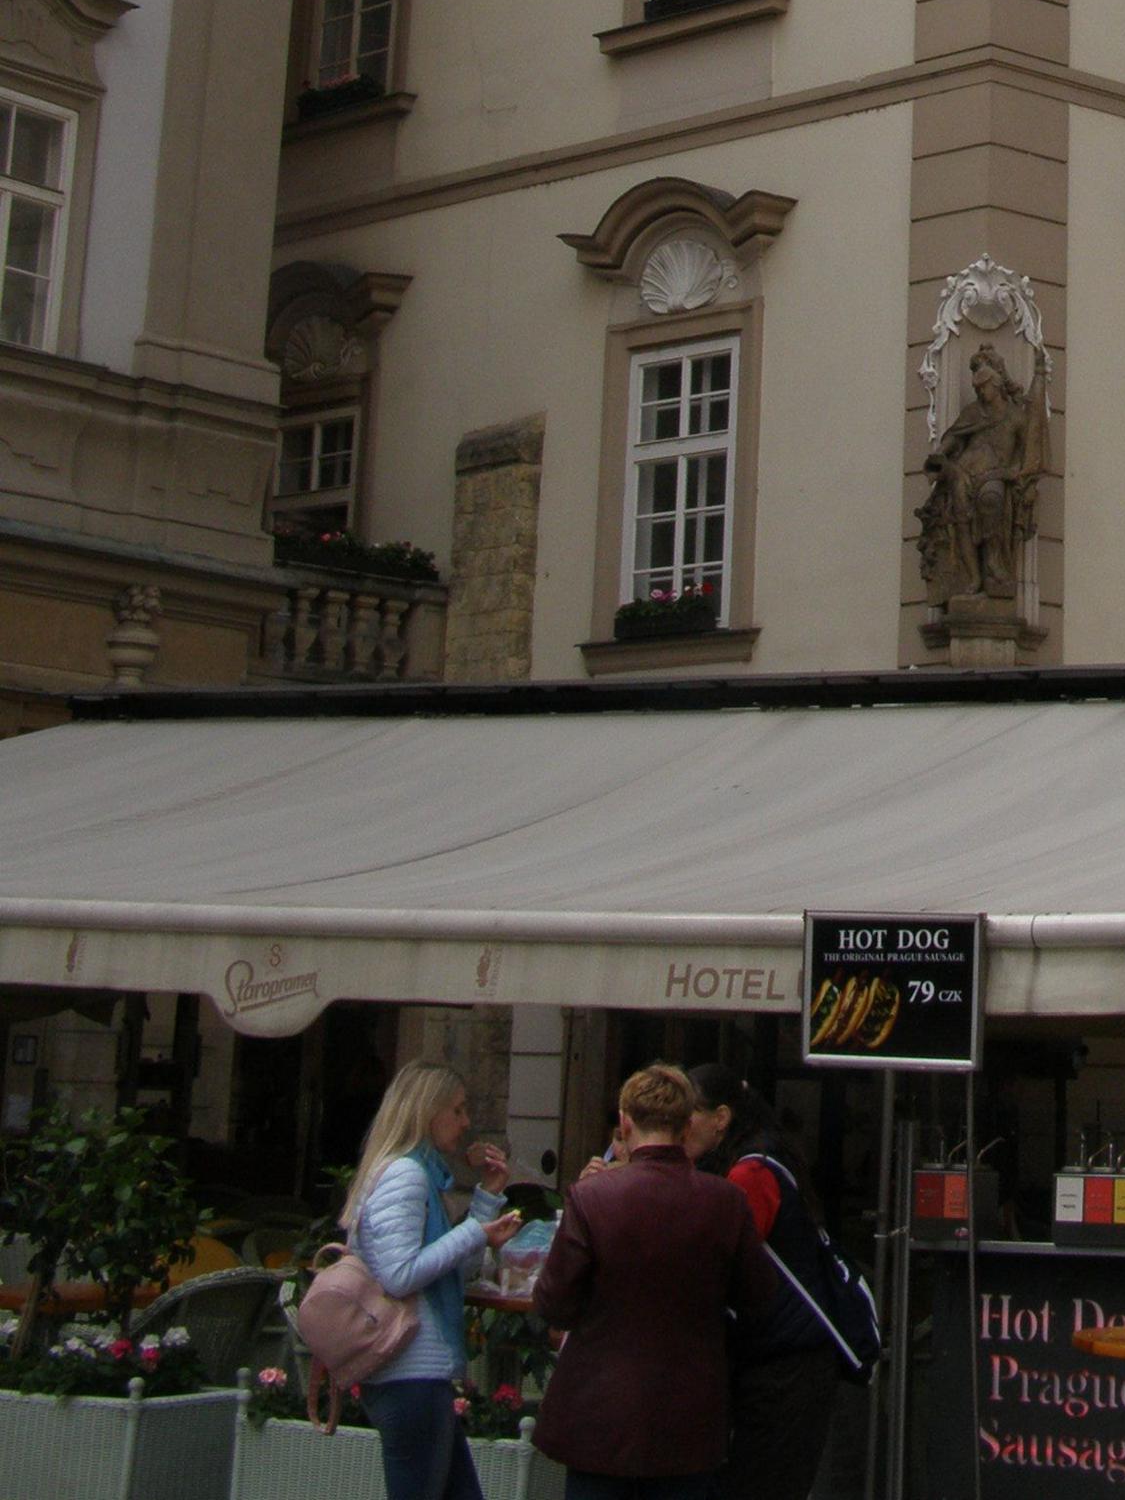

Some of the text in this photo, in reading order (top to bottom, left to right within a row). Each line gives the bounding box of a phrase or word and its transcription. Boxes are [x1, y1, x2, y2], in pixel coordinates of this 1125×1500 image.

[837, 929, 951, 951] HOT DOG
[823, 952, 966, 963] THE ORIGINAL PRAGUE SAUSAGE
[224, 959, 321, 1018] Staropramen
[664, 963, 786, 1001] HOTEL
[907, 979, 964, 1003] 79 CZK
[979, 1293, 1056, 1344] Hot
